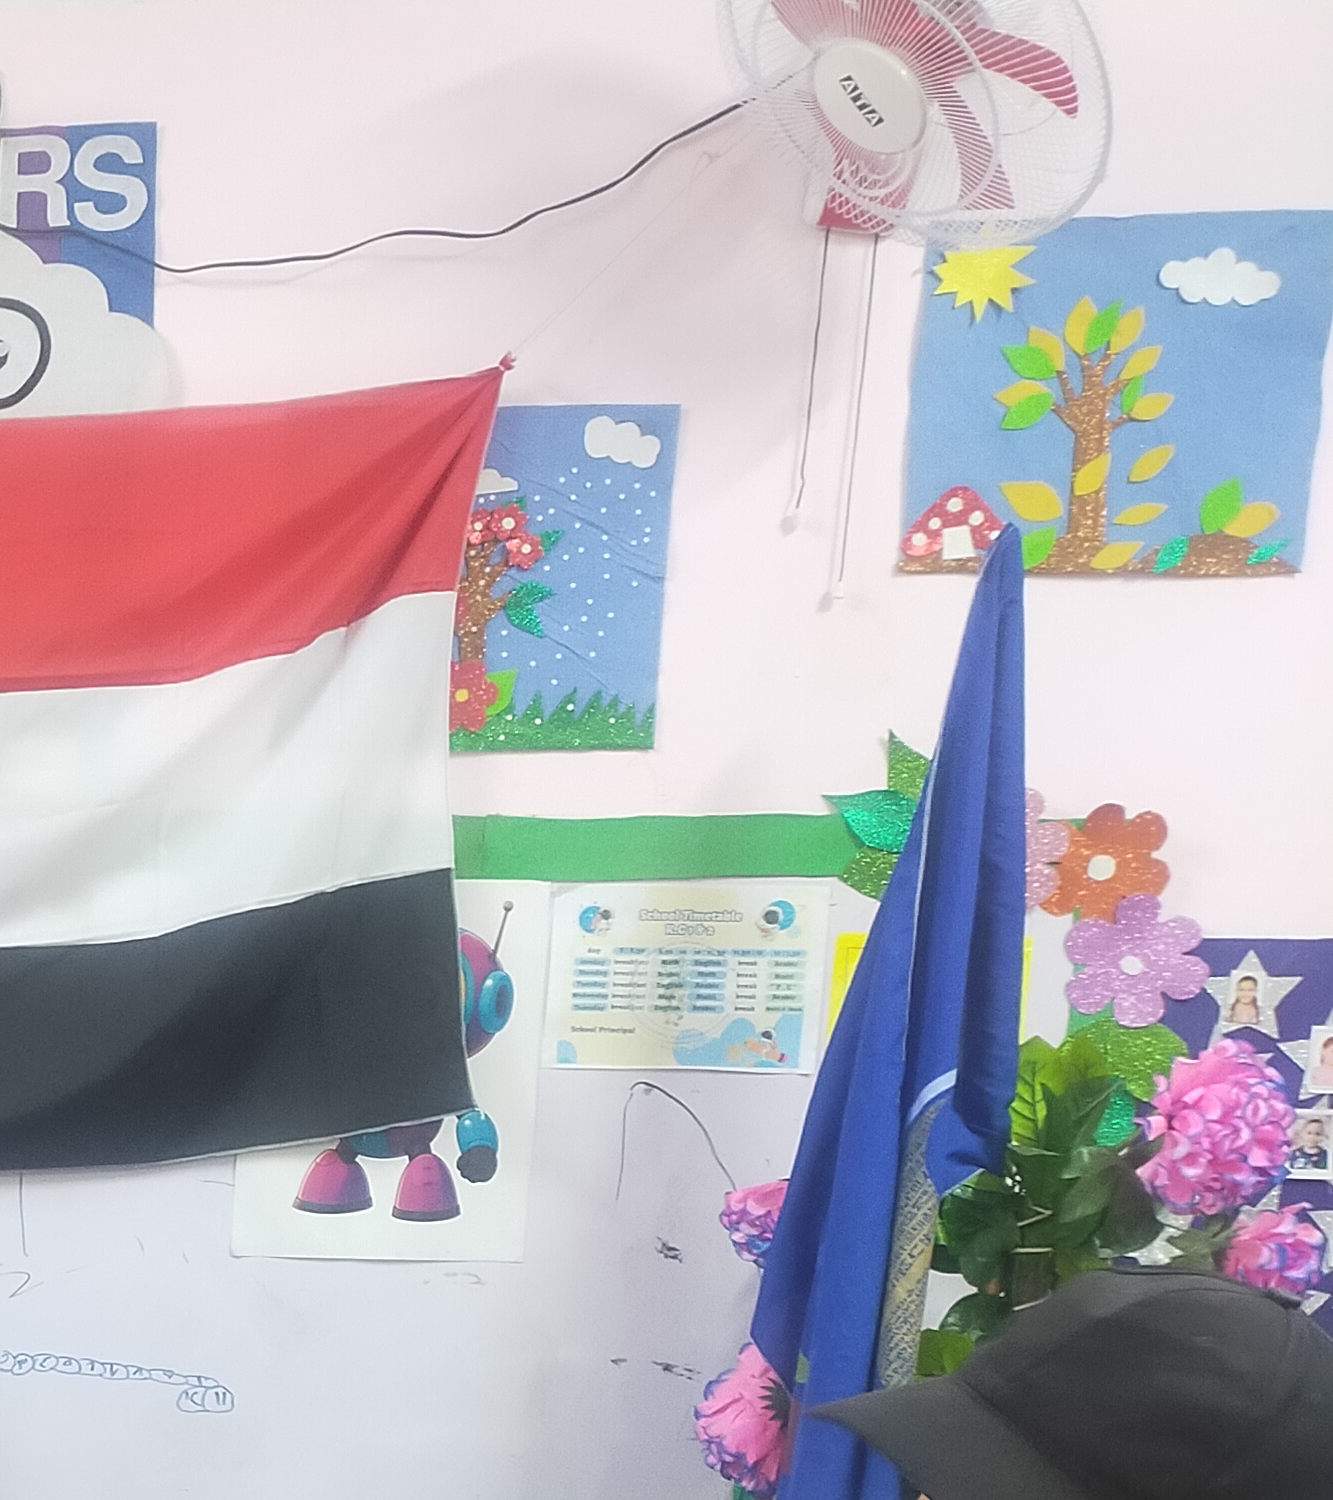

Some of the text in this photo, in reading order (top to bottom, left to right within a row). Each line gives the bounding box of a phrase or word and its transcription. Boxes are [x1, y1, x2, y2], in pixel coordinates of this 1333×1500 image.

[839, 74, 884, 127] ATA
[639, 909, 743, 922] School Timetable
[571, 1025, 596, 1033] School
